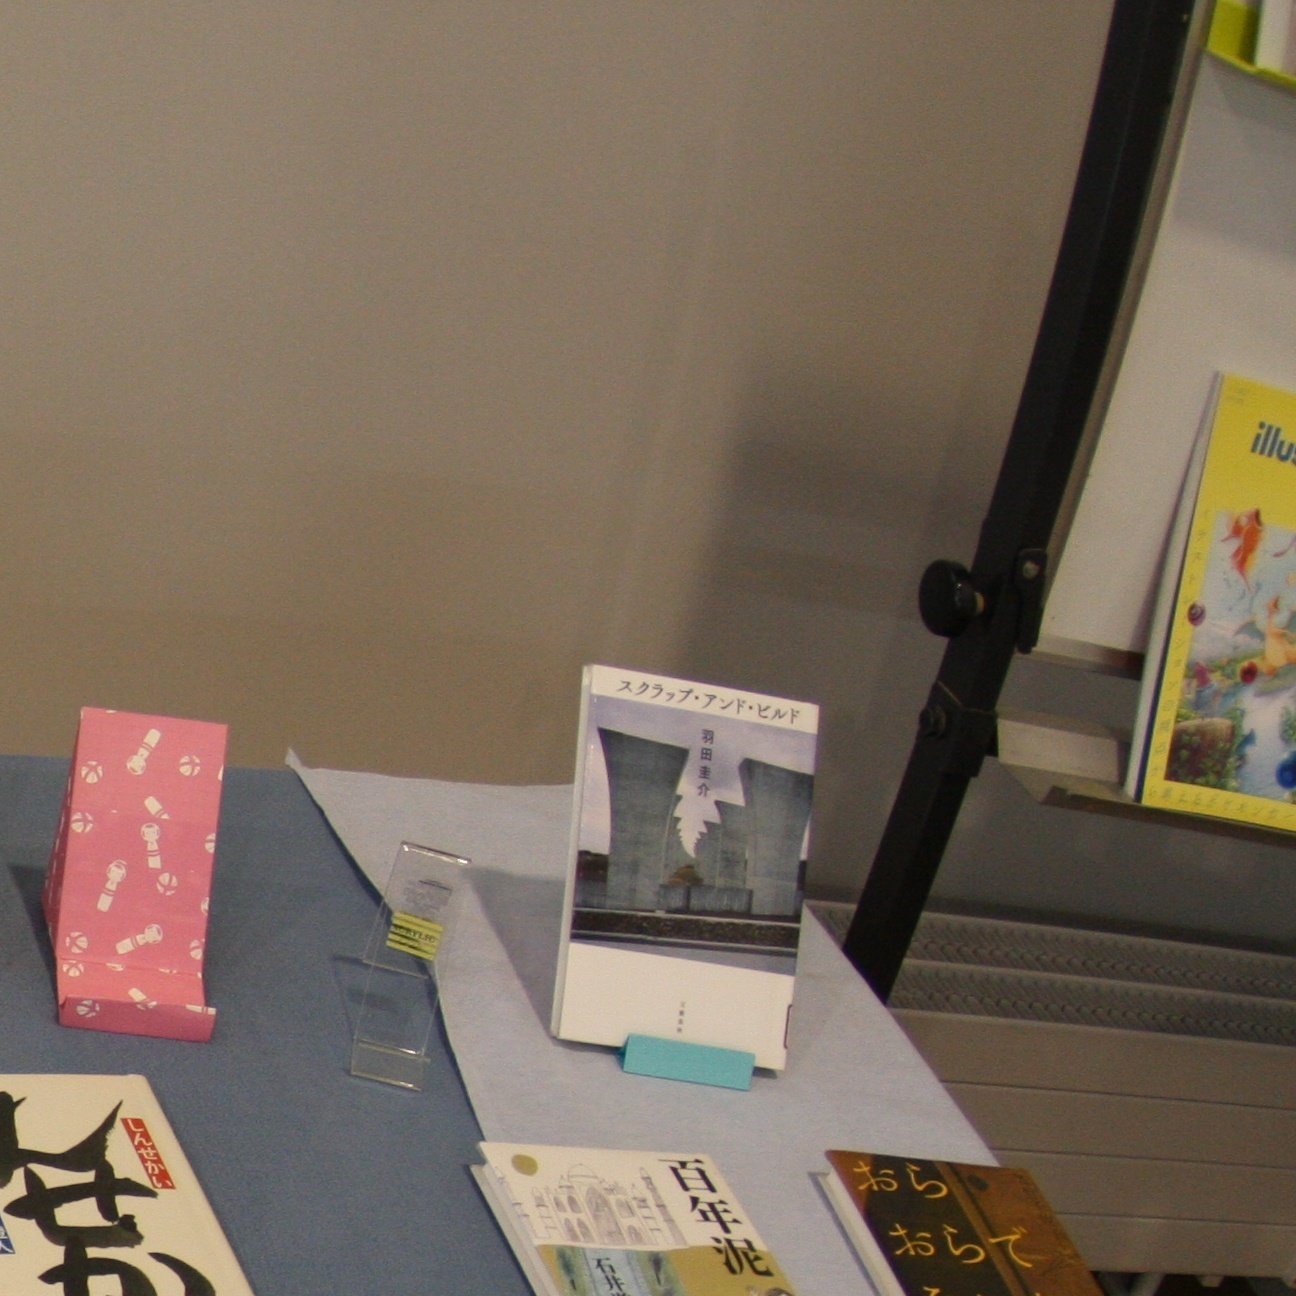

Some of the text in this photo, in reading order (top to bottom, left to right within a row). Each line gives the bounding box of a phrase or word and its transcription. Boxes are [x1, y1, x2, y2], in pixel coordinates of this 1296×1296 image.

[616, 679, 800, 724] スクラップ・アンド・ビルド
[697, 729, 714, 796] 羽田圭介
[128, 1119, 174, 1189] しんせかい
[854, 1161, 948, 1198] おら
[659, 1158, 774, 1277] 百年泥
[889, 1224, 1033, 1267] おらで
